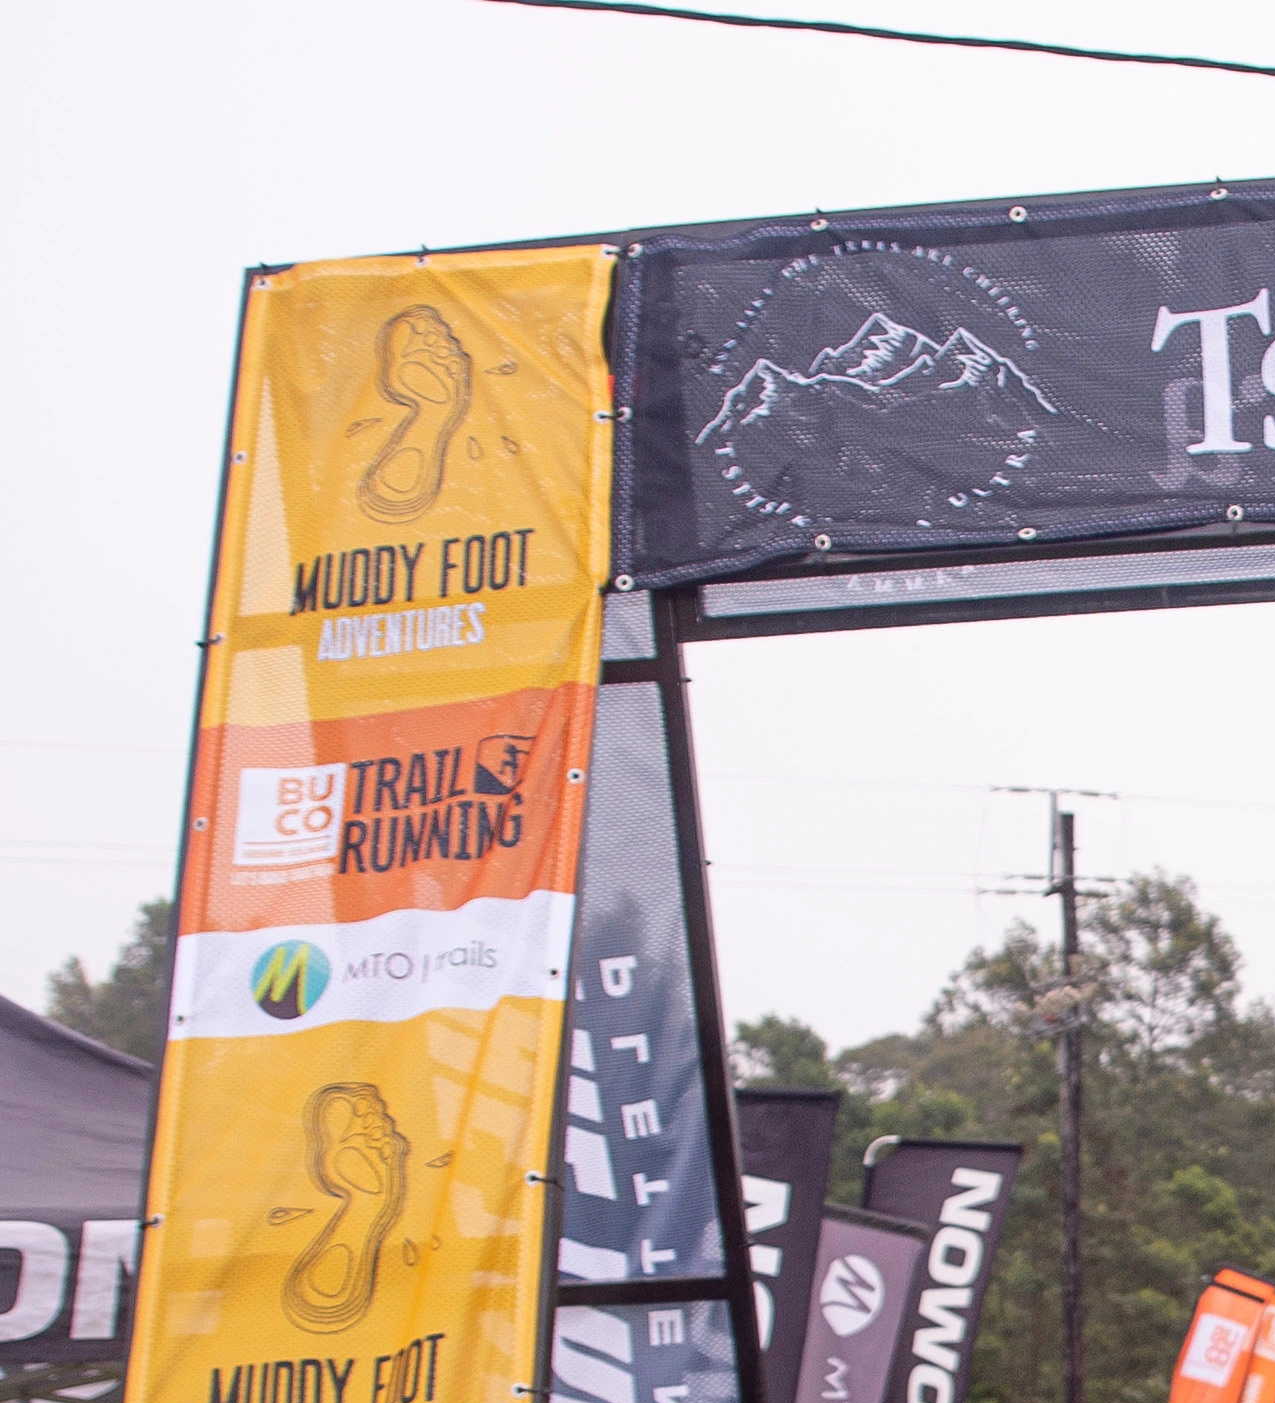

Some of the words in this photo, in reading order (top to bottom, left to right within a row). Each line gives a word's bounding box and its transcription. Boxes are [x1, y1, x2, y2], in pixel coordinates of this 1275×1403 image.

[289, 541, 425, 616] MUDDY
[440, 529, 534, 599] FOOT
[316, 602, 487, 663] ADVENTURES
[349, 746, 467, 815] TRAIL
[338, 793, 524, 875] RUNNING
[343, 951, 414, 984] MTO
[433, 940, 498, 972] rails
